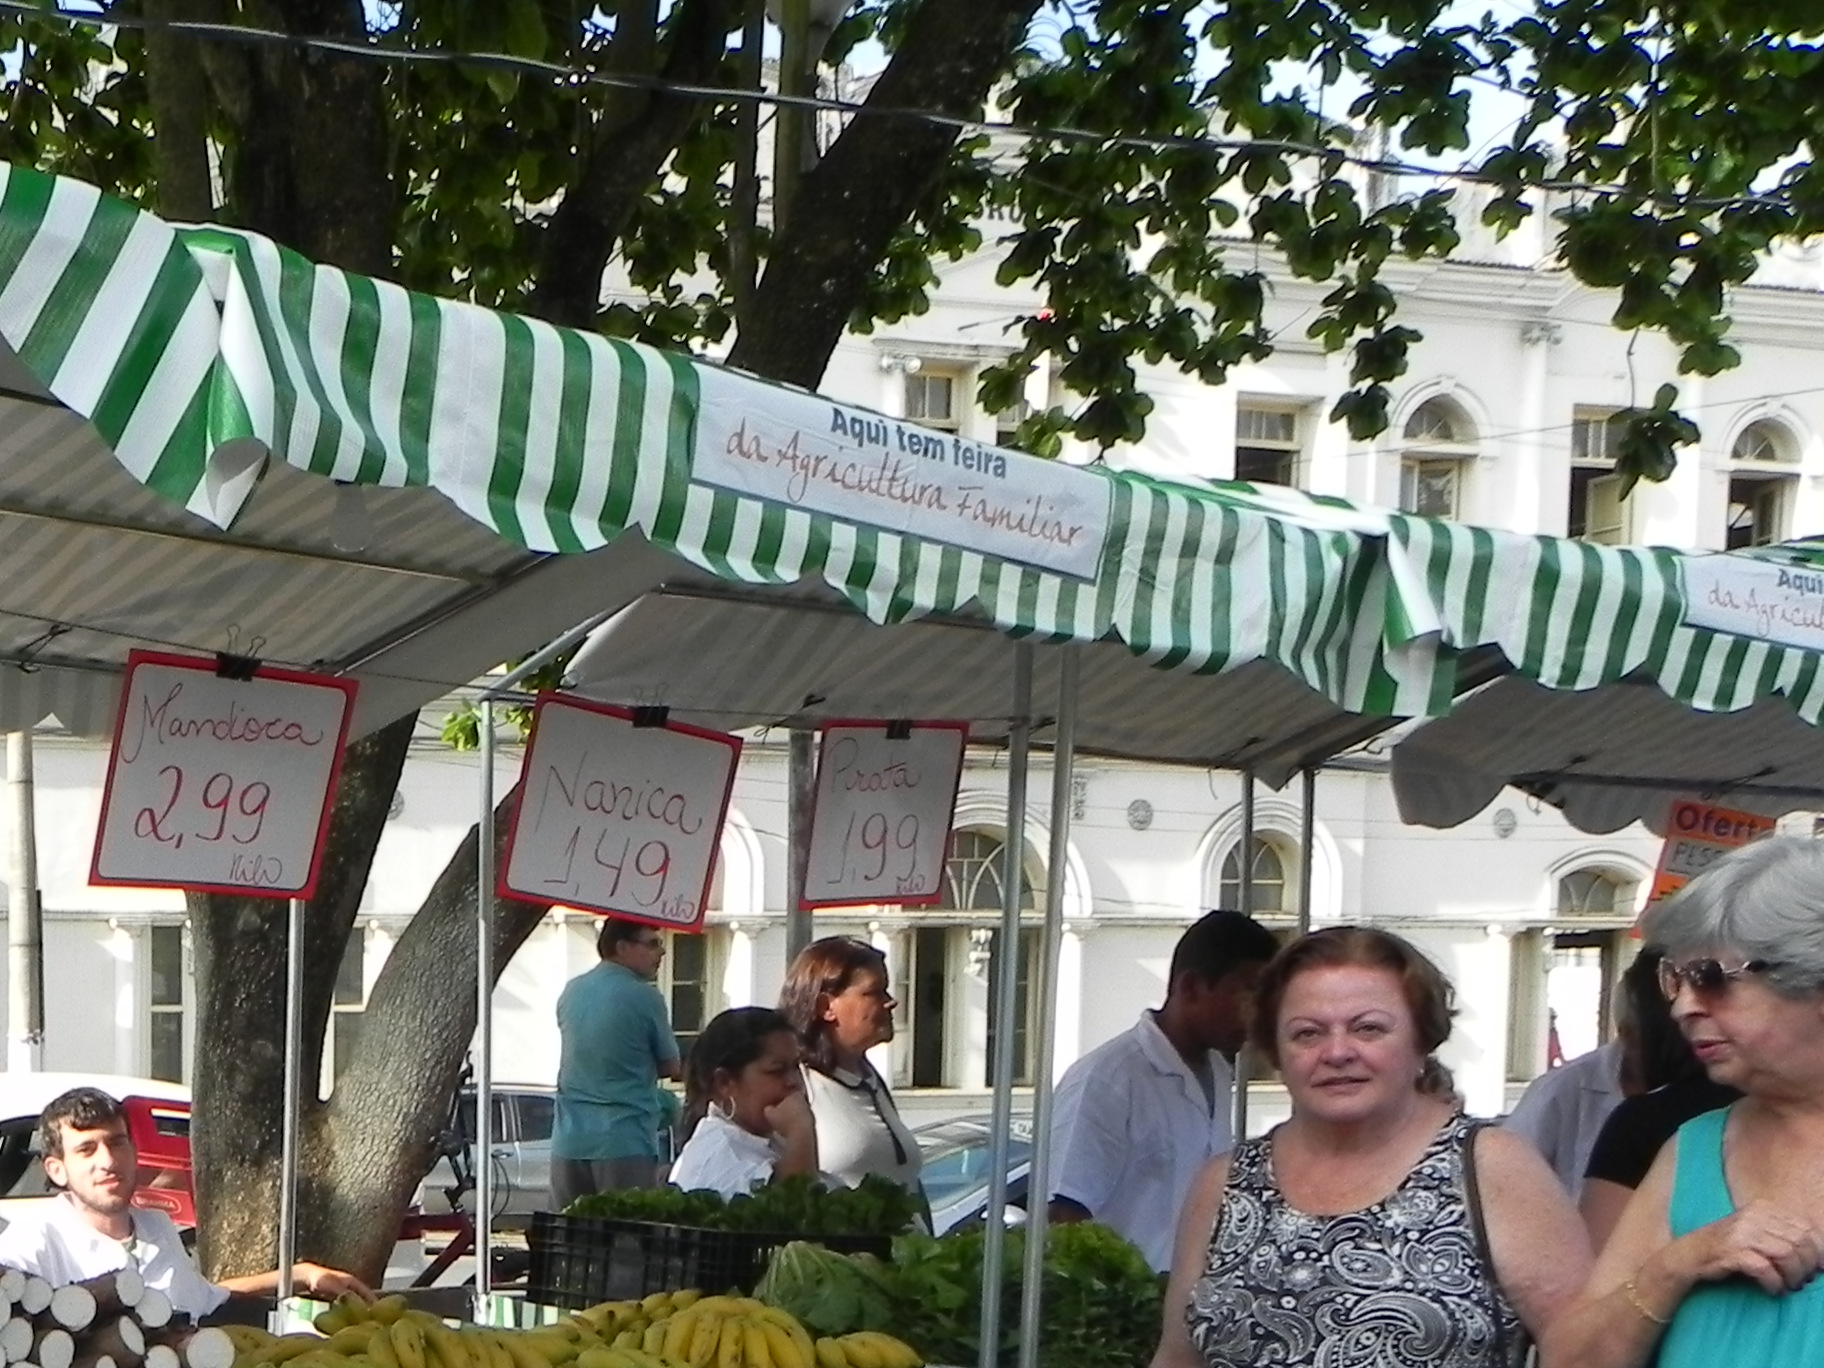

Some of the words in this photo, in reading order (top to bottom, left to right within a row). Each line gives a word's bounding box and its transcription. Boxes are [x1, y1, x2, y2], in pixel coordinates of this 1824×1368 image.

[830, 406, 889, 449] Aqui
[896, 424, 946, 462] tem
[954, 438, 1008, 479] feira
[727, 416, 769, 464] da
[776, 430, 949, 512] Agricultura
[955, 485, 1084, 548] Familiar
[1707, 578, 1741, 610] da
[1776, 567, 1824, 597] Aqui
[120, 682, 324, 764] Mandioca
[534, 750, 703, 835] Nanica
[827, 736, 923, 793] Prata
[133, 765, 272, 850] 2,99
[1675, 804, 1759, 840] Ofert
[543, 825, 672, 907] 1,49
[826, 810, 920, 885] 1,99
